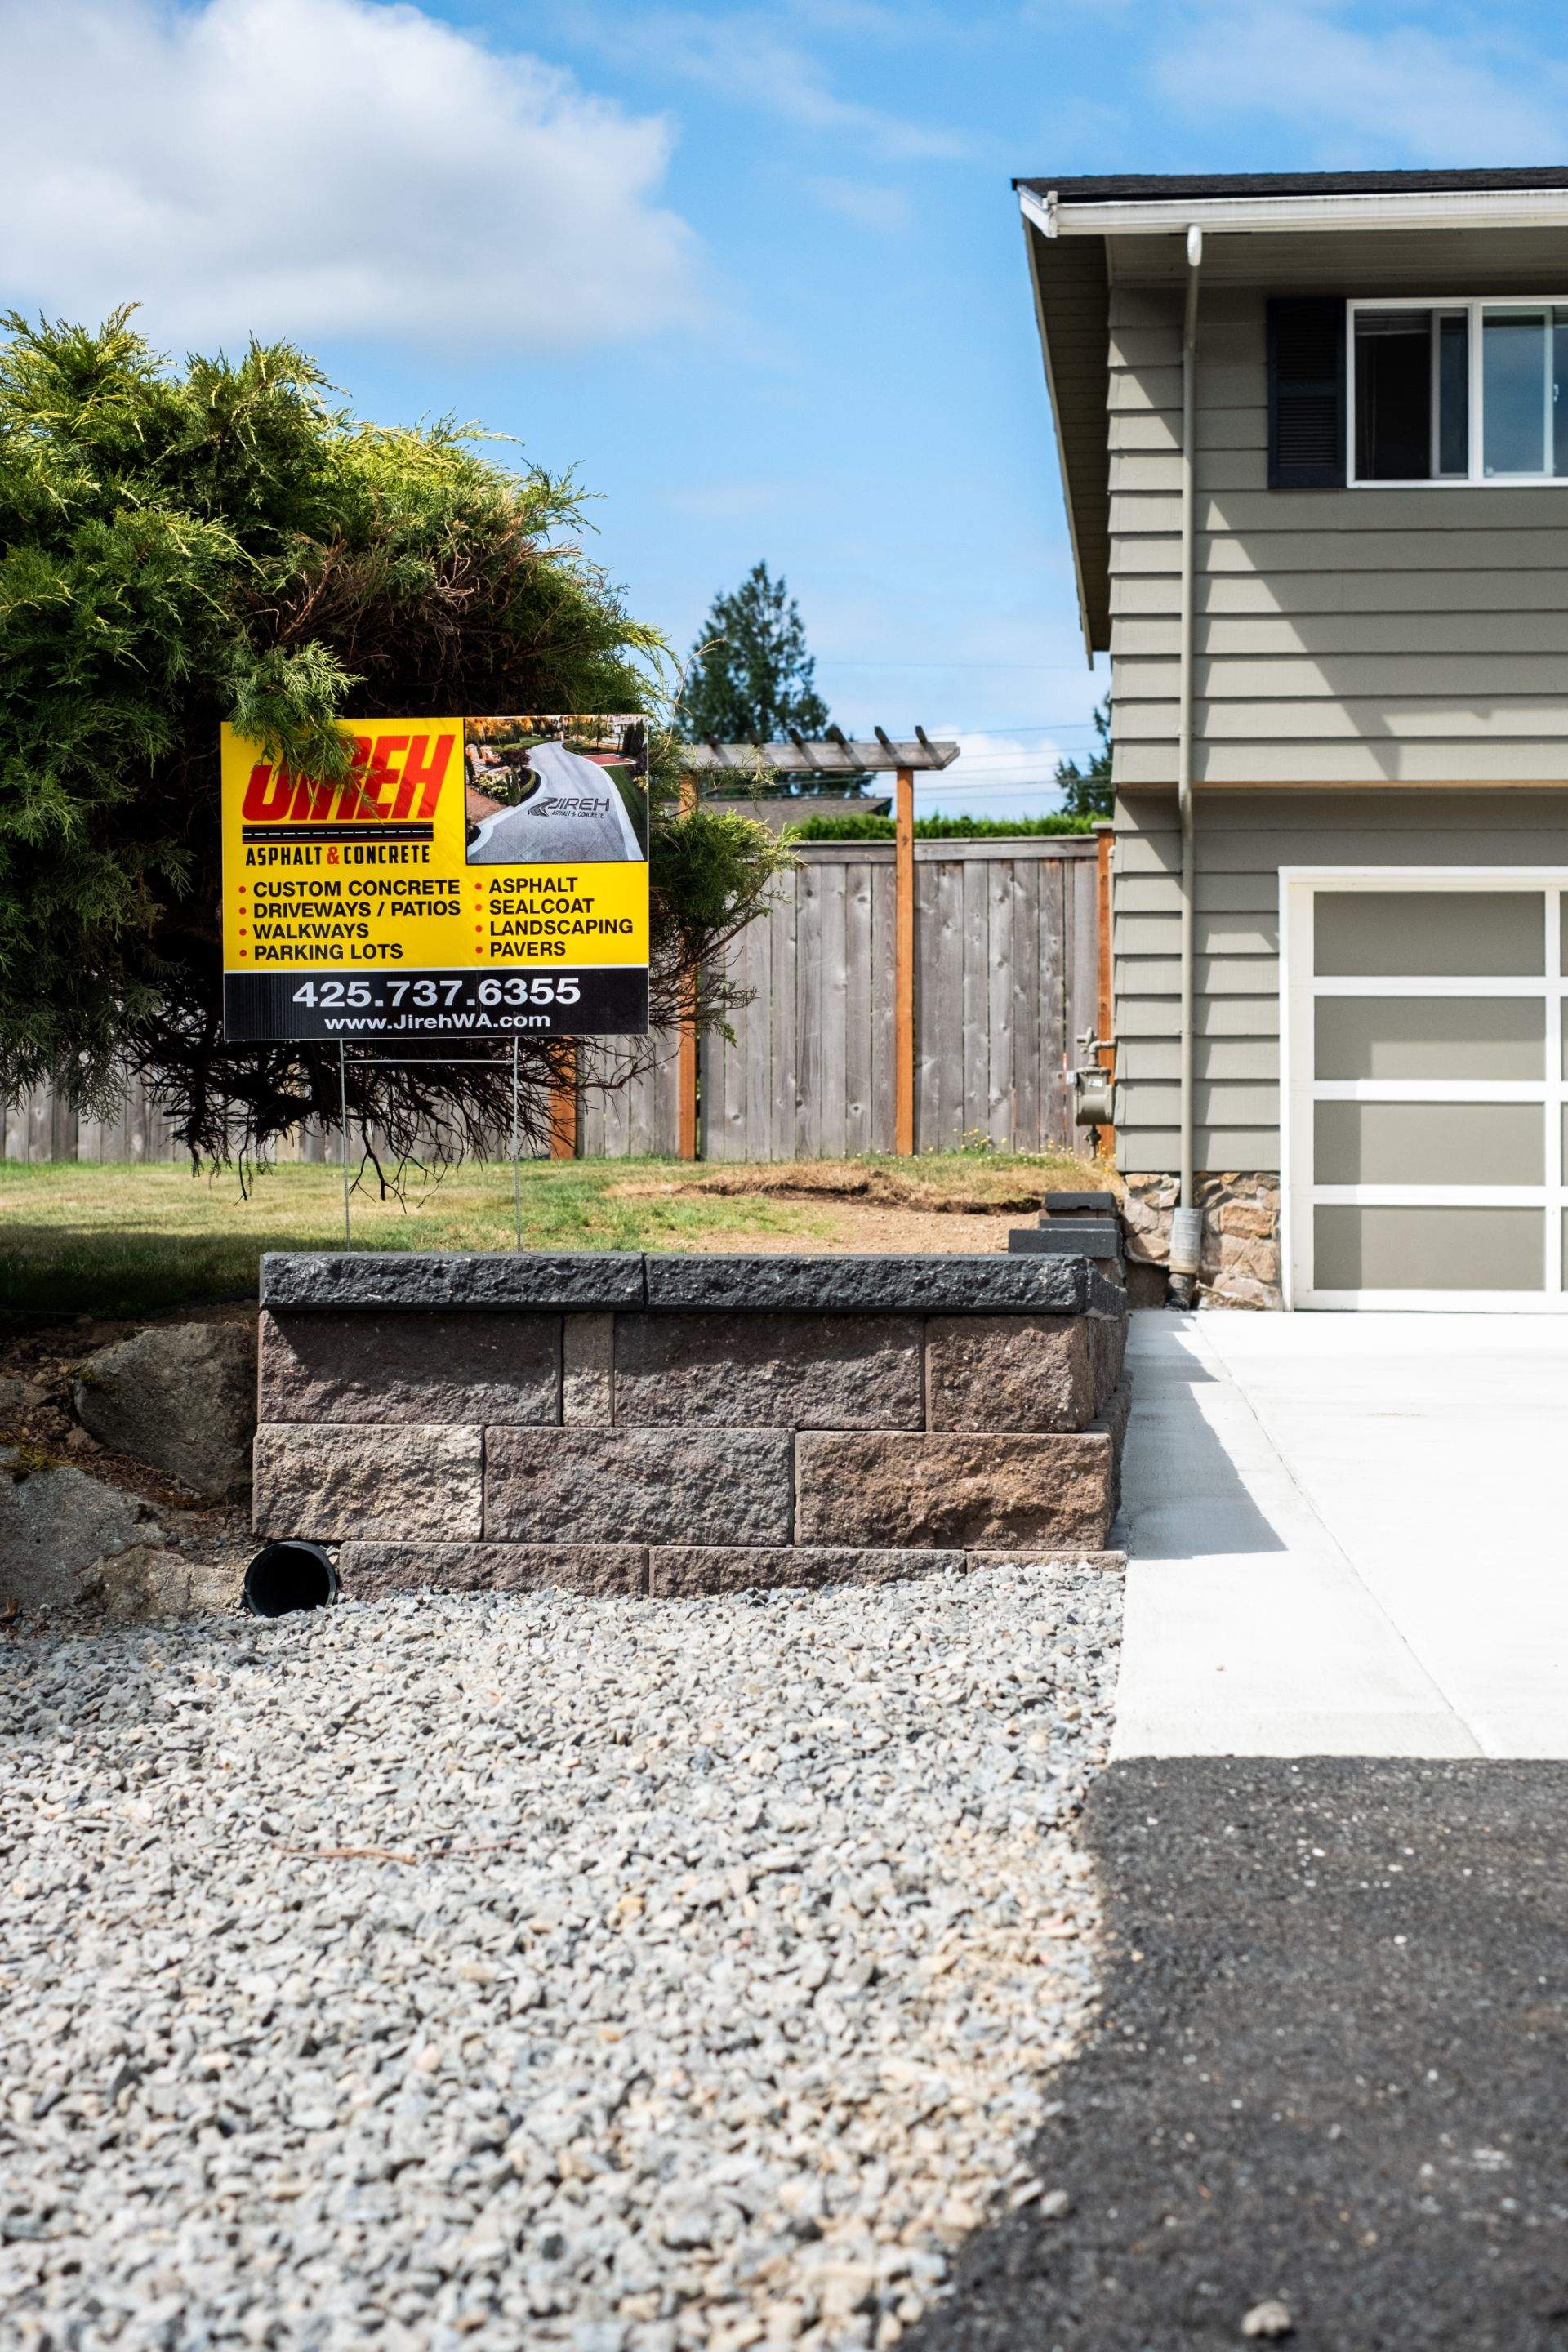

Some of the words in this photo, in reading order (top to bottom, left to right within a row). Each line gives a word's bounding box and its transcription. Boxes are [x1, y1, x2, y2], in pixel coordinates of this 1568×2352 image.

[548, 797, 610, 811] JIREH
[577, 811, 604, 819] CONCRETE
[246, 847, 322, 866] ASPHALT
[327, 847, 339, 864] &
[344, 845, 429, 864] CONCRETE
[254, 881, 341, 897] CUSTOM
[349, 880, 460, 896] CONCRETE
[489, 878, 577, 893] ASPHALT
[254, 902, 371, 918] DRIVEWAYS
[377, 902, 385, 916] /
[392, 901, 460, 916] PATIOS
[490, 898, 594, 915] SEALCOAT
[253, 923, 368, 939] WALKWAYS
[491, 919, 632, 936] LANDSCAPING
[255, 945, 343, 960] PARKING
[351, 943, 403, 959] LOTS
[491, 941, 565, 956] PAVERS
[293, 978, 580, 1007] 425.737.6355
[324, 1013, 550, 1029] www.JirehWA.com
